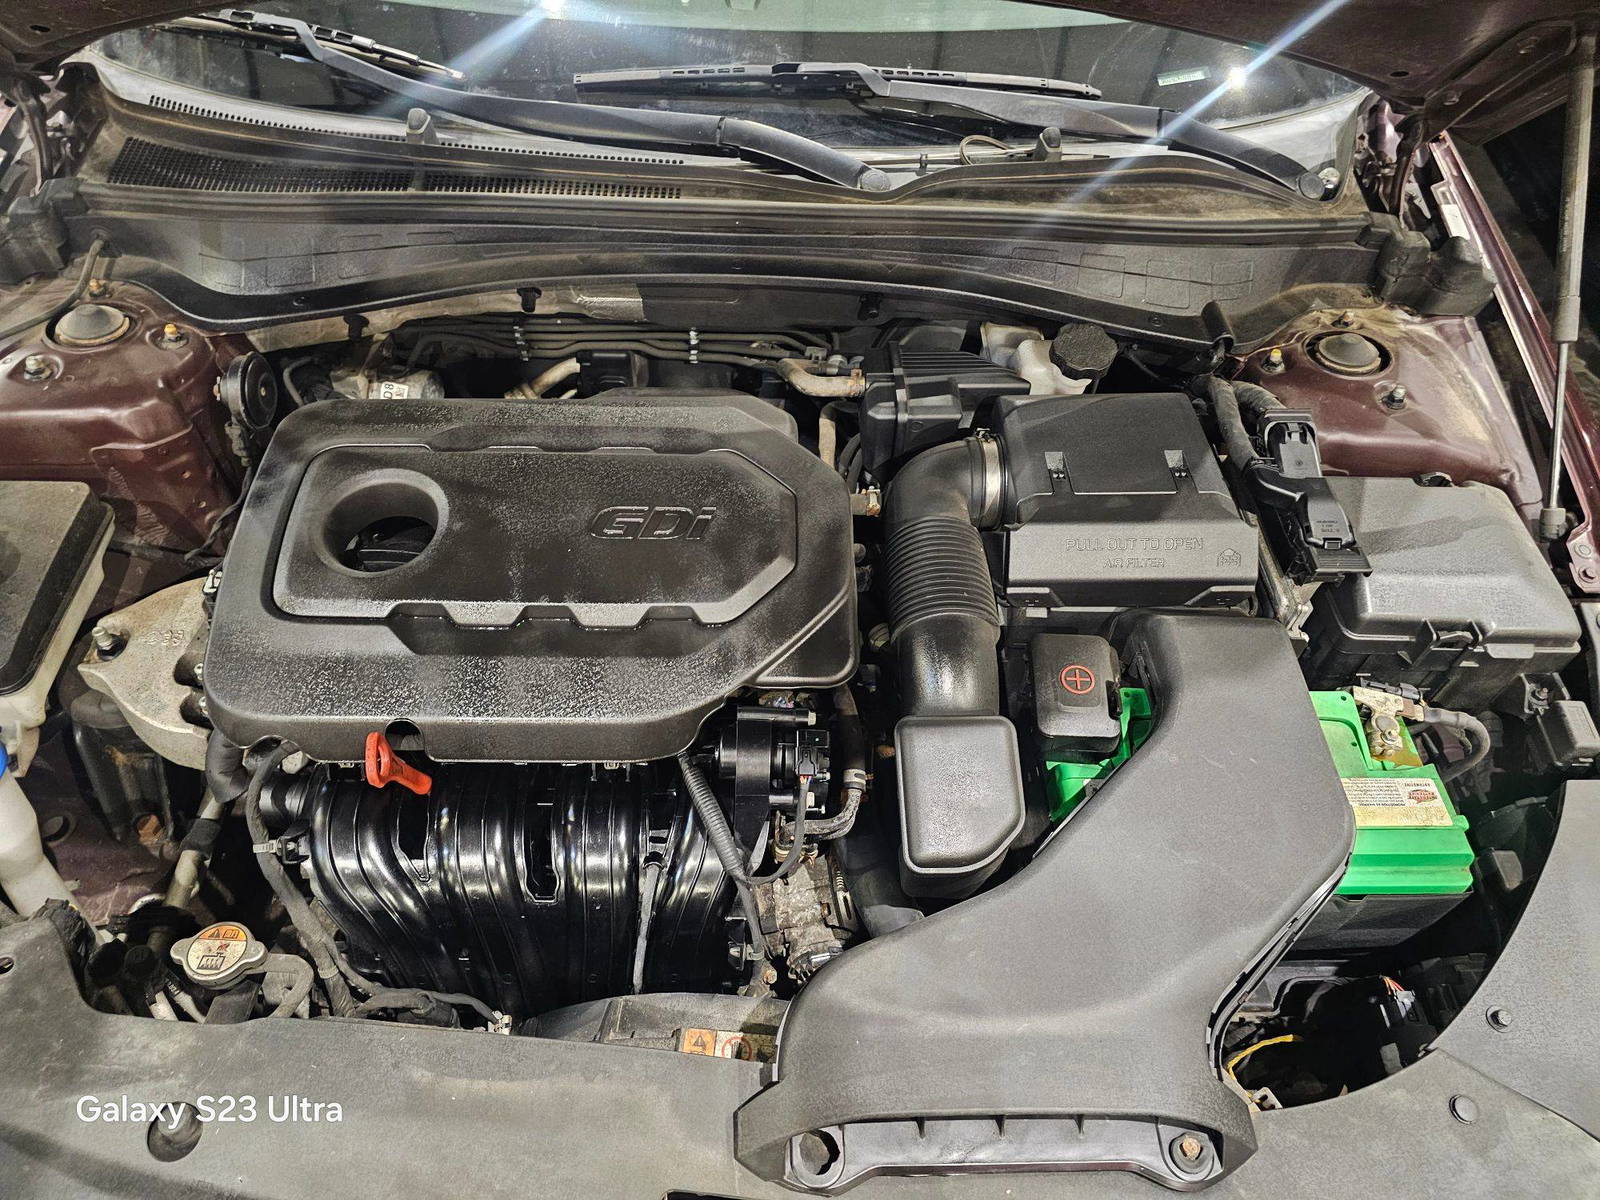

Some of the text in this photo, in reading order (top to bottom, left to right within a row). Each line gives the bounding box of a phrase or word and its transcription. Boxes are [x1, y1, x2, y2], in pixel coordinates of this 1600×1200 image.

[590, 505, 717, 540] GDi
[1065, 536, 1204, 552] PULL OUT TO OPEN
[1103, 557, 1167, 568] AIR FILTER
